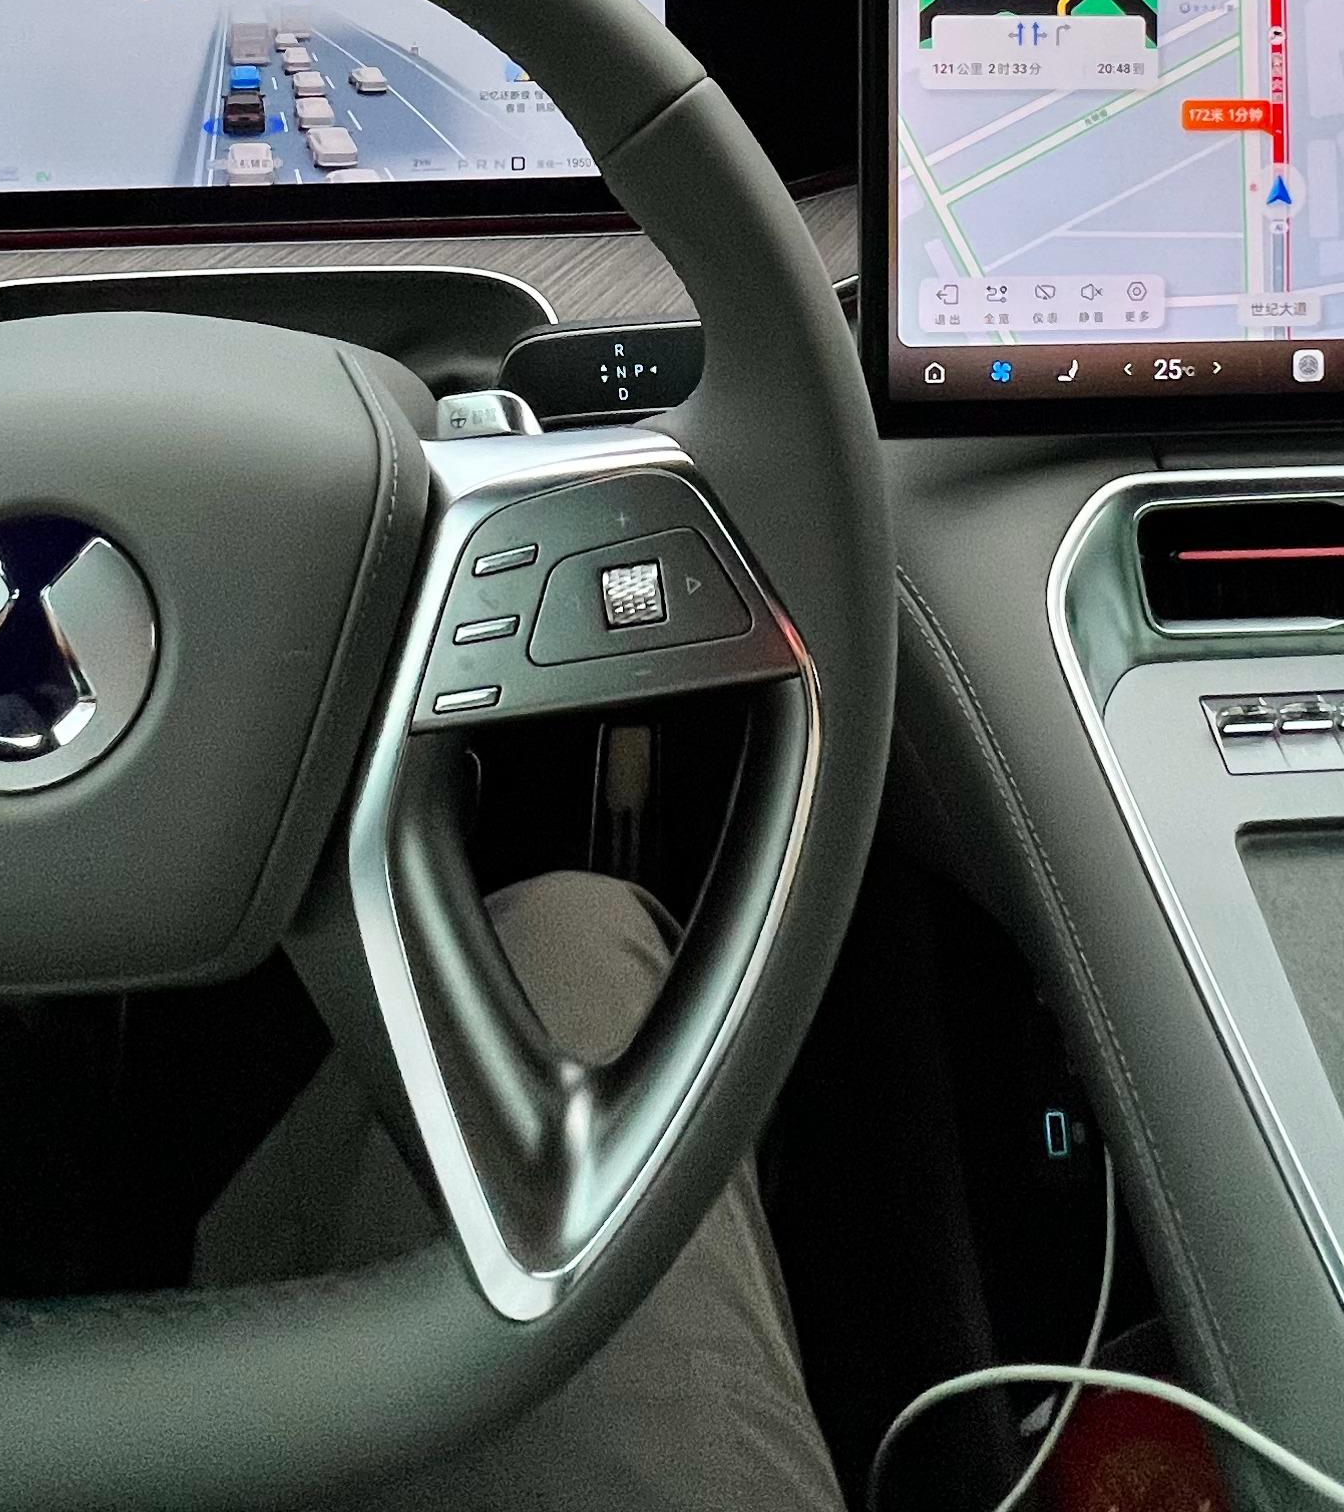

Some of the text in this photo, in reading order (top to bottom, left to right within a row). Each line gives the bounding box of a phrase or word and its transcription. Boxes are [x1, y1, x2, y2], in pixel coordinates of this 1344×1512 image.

[1251, 301, 1308, 317] 世纪大道
[614, 343, 625, 357] R
[616, 364, 644, 379] N P
[618, 388, 629, 401] D
